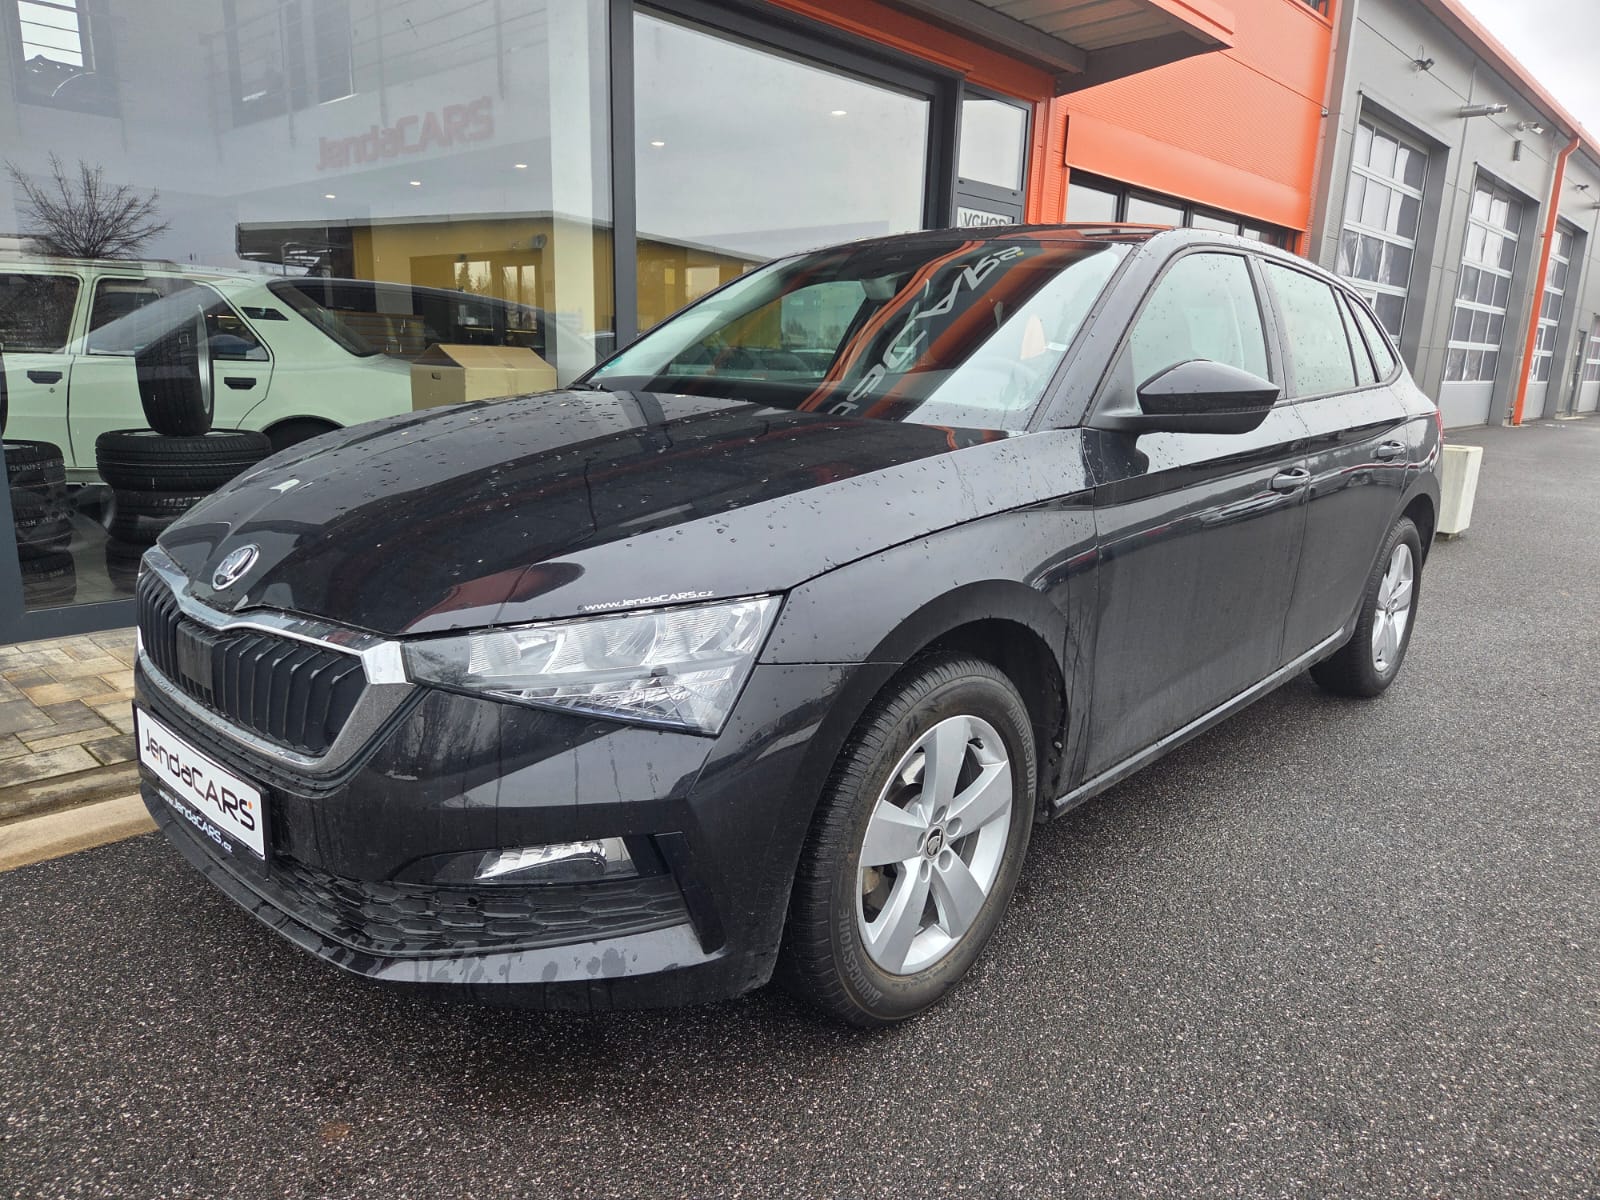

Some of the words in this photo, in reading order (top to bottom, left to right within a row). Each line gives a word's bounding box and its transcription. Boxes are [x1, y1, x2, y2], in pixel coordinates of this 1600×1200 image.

[316, 95, 494, 171] JendaCARS
[584, 590, 715, 611] www.JendaCARS.cz
[145, 728, 256, 832] JendaCARS
